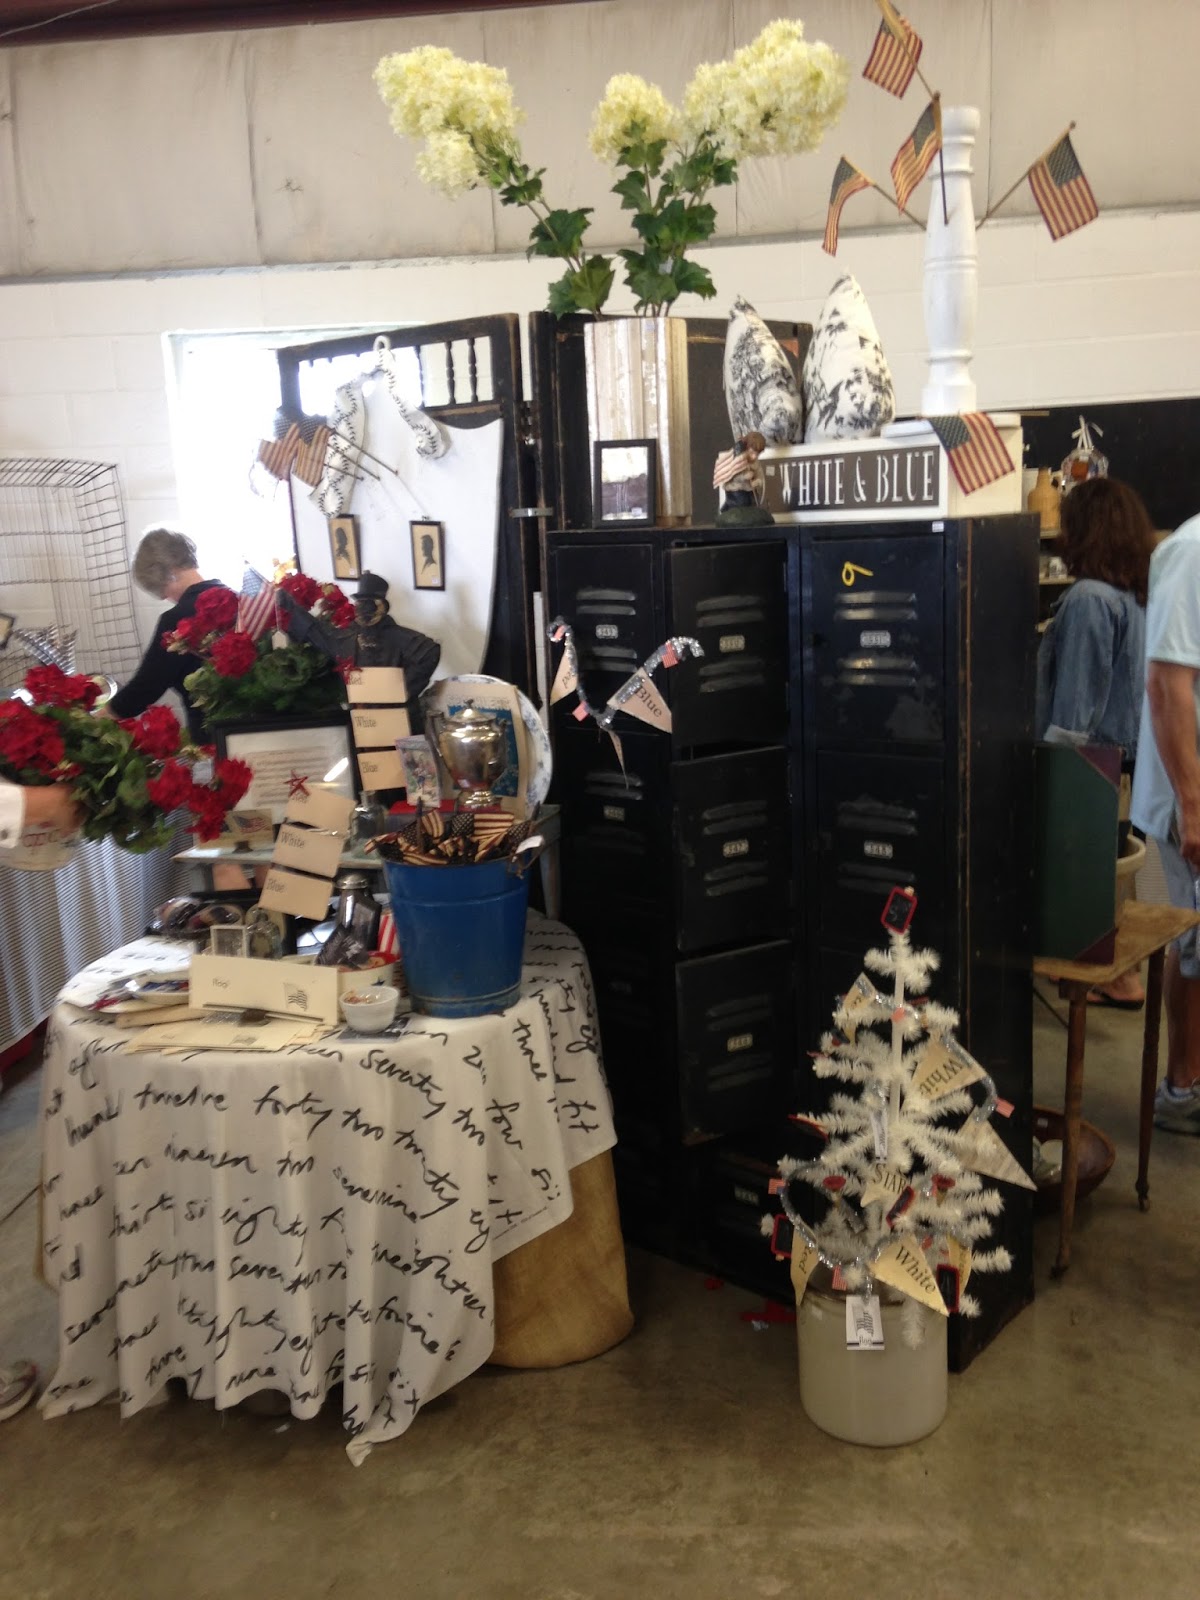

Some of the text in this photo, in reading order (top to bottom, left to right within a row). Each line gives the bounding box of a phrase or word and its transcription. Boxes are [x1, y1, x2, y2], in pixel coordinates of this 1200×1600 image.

[779, 450, 935, 506] WHITE & BLUE
[634, 686, 663, 718] Blue
[919, 1058, 964, 1095] Whit
[895, 1246, 936, 1294] White
